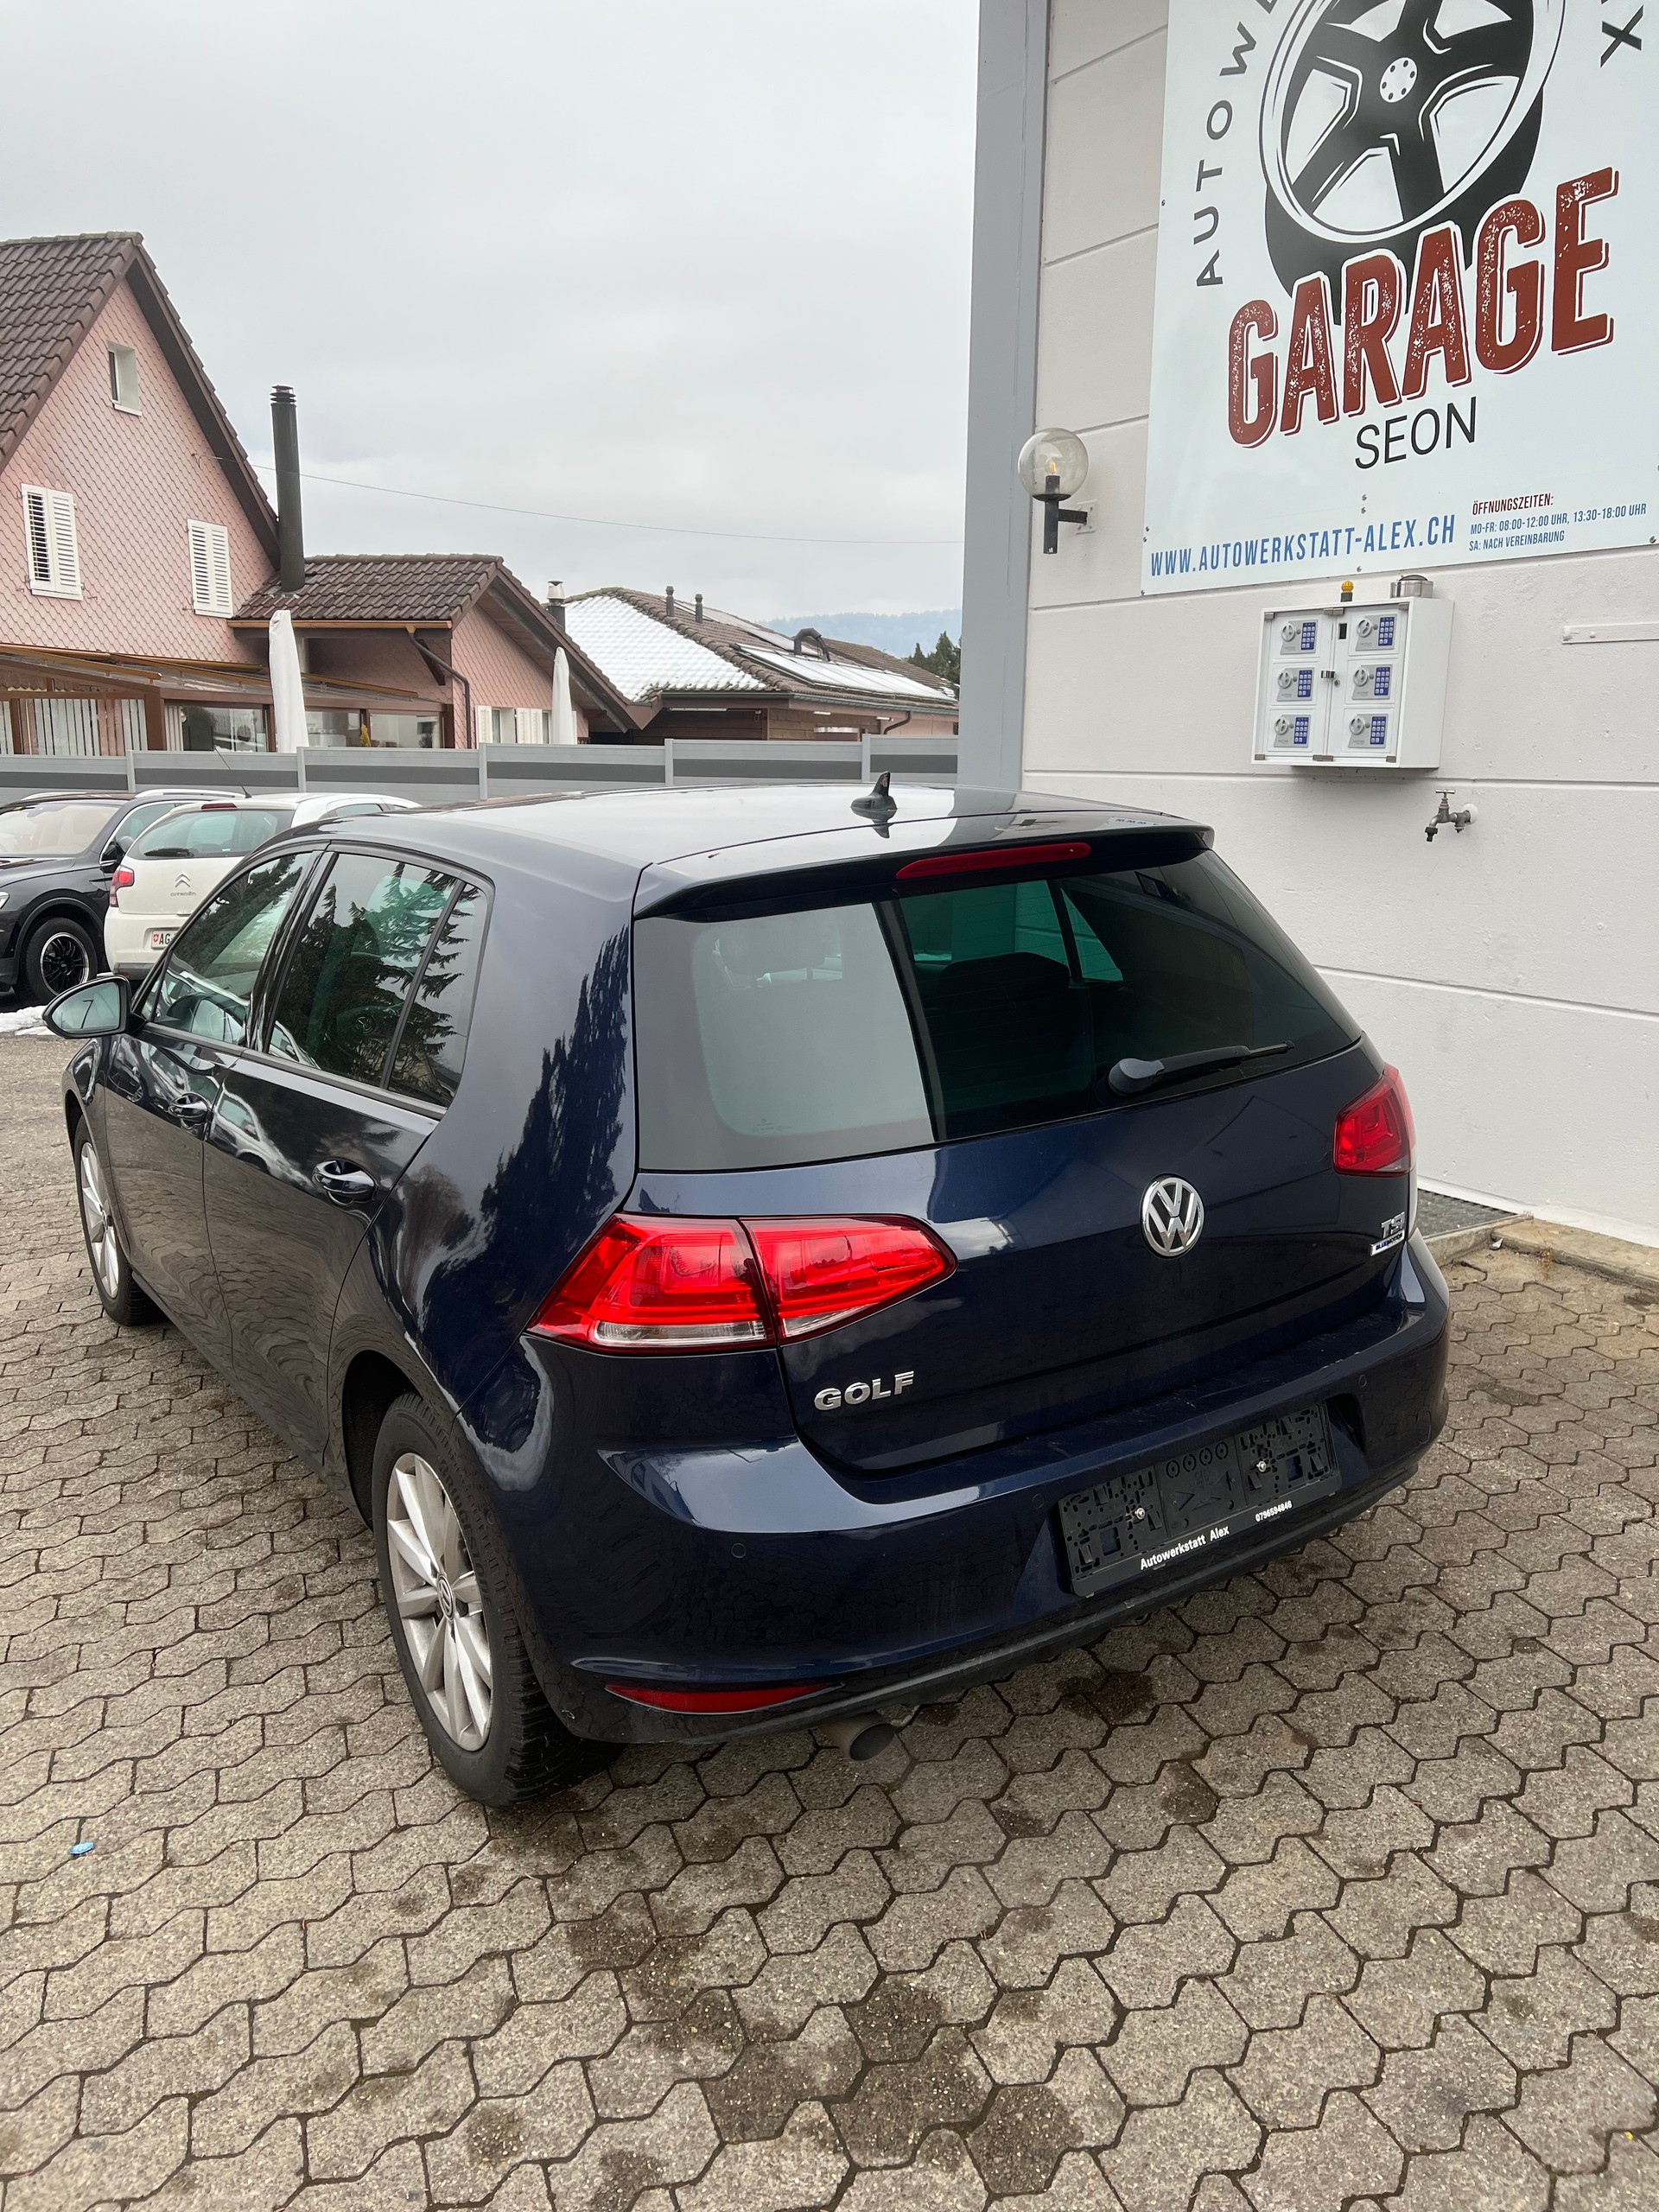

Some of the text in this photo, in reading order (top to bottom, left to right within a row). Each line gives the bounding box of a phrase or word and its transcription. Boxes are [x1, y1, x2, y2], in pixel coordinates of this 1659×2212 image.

[1193, 0, 1643, 287] AUTOW X
[1228, 166, 1619, 448] GARAGE
[1355, 397, 1477, 469] SEON
[1471, 503, 1647, 535] MO-FR: 08:00-12:00 UHR, 13:30-18:00 UHR
[1472, 493, 1554, 515] ÖFFNUNGSZEITEN:
[1151, 514, 1455, 576] WWW.AUTOWERKSTATT-ALEX.CH
[1469, 531, 1565, 551] SA: NACH VEREINBARUNG
[814, 1370, 914, 1411] GOLF
[1140, 1525, 1230, 1570] Autowerkstatt Alex
